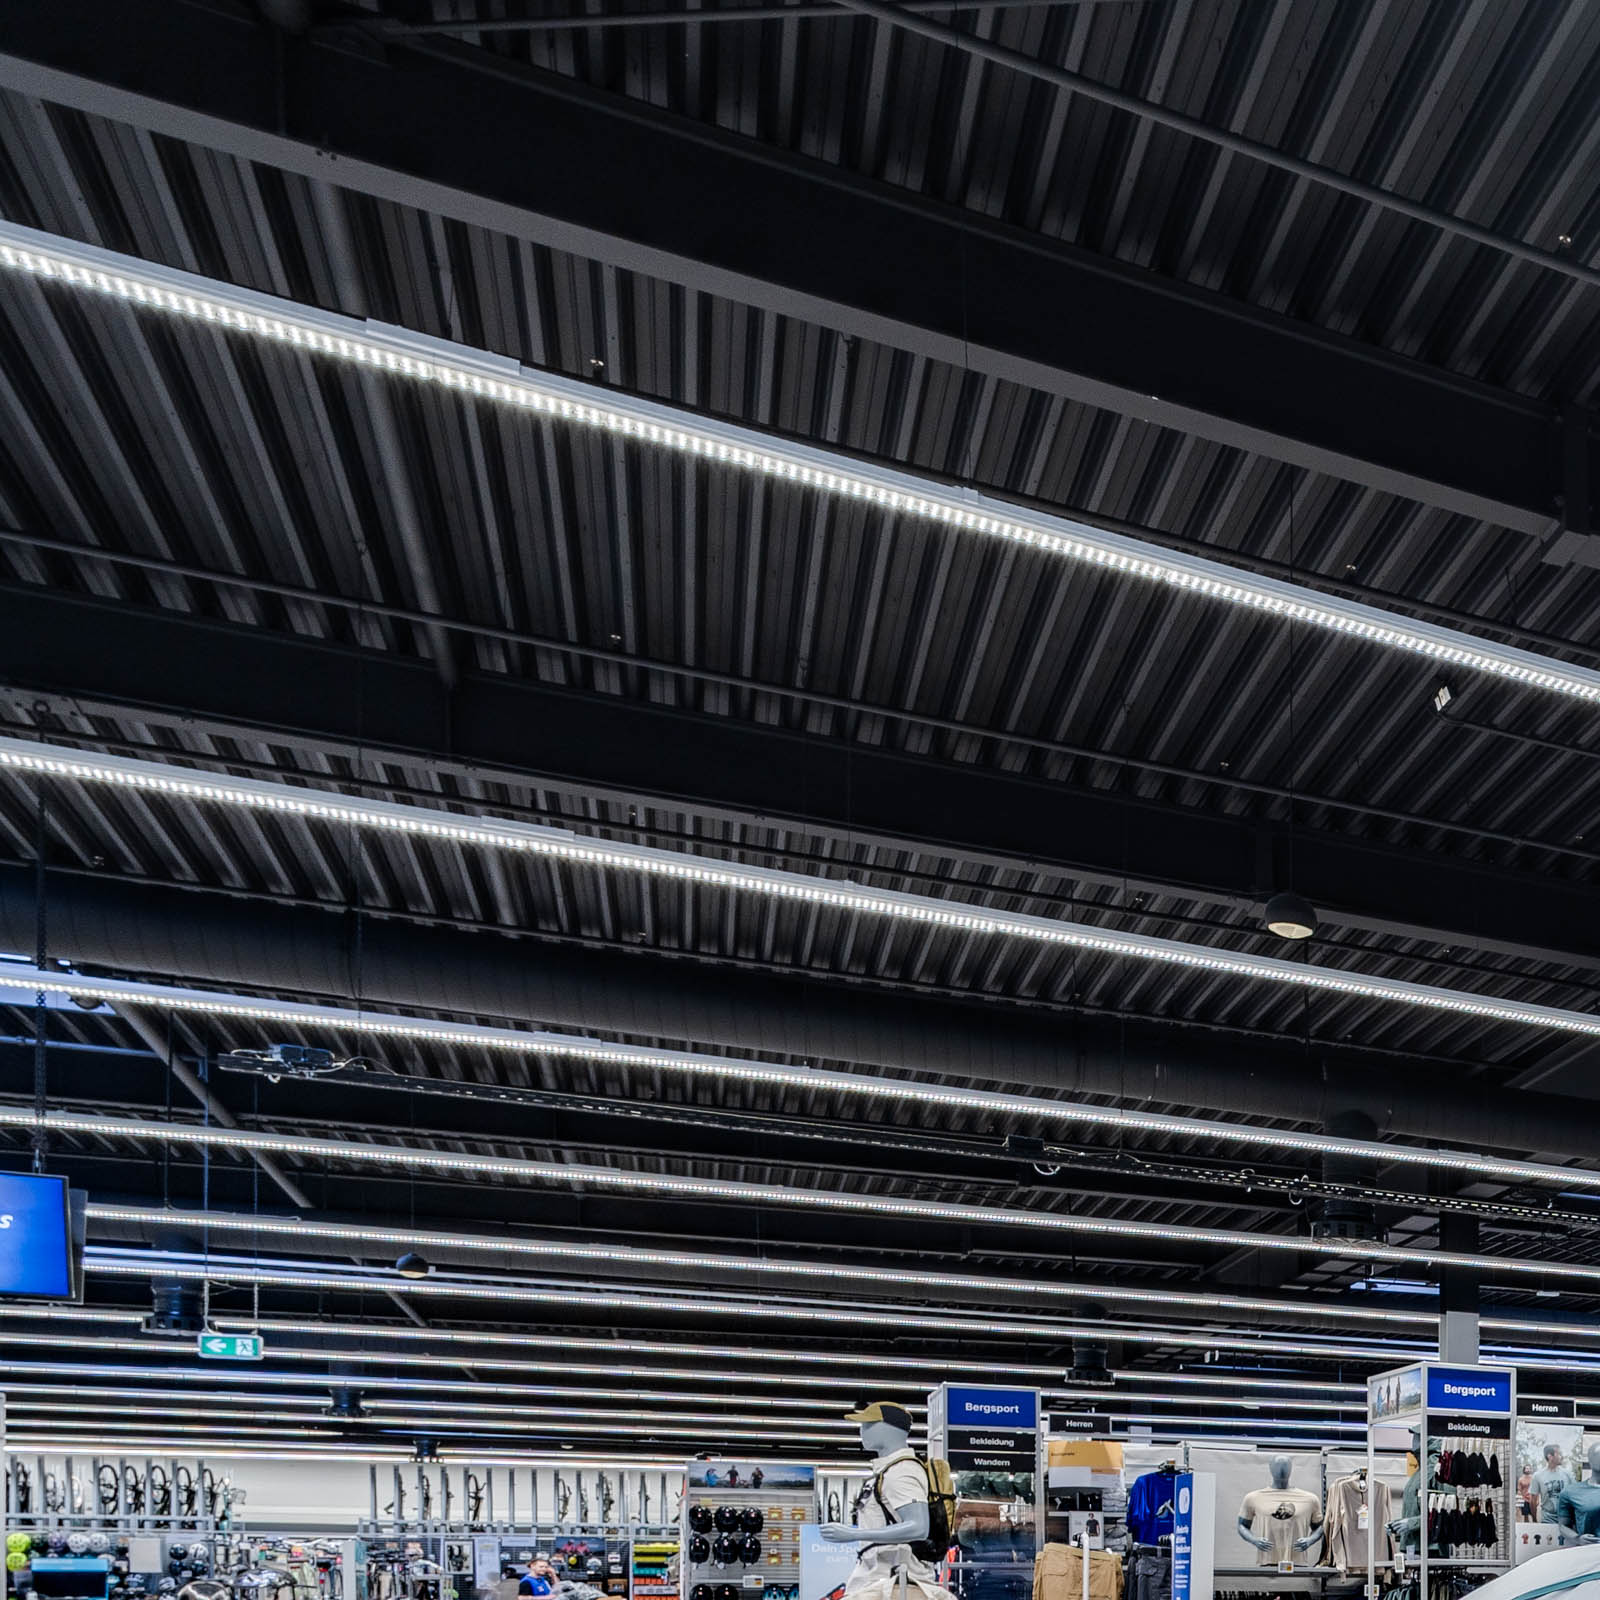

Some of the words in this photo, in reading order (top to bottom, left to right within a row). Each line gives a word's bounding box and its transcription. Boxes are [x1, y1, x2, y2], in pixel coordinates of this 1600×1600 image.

[1444, 1384, 1496, 1397] Bergsport
[965, 1402, 1020, 1414] Bergsport
[1532, 1404, 1559, 1412] Herren
[1066, 1419, 1093, 1428] Herren
[1448, 1423, 1490, 1433] Bekleidung
[970, 1437, 1014, 1447] Bekleidung
[974, 1458, 1010, 1466] Wandern
